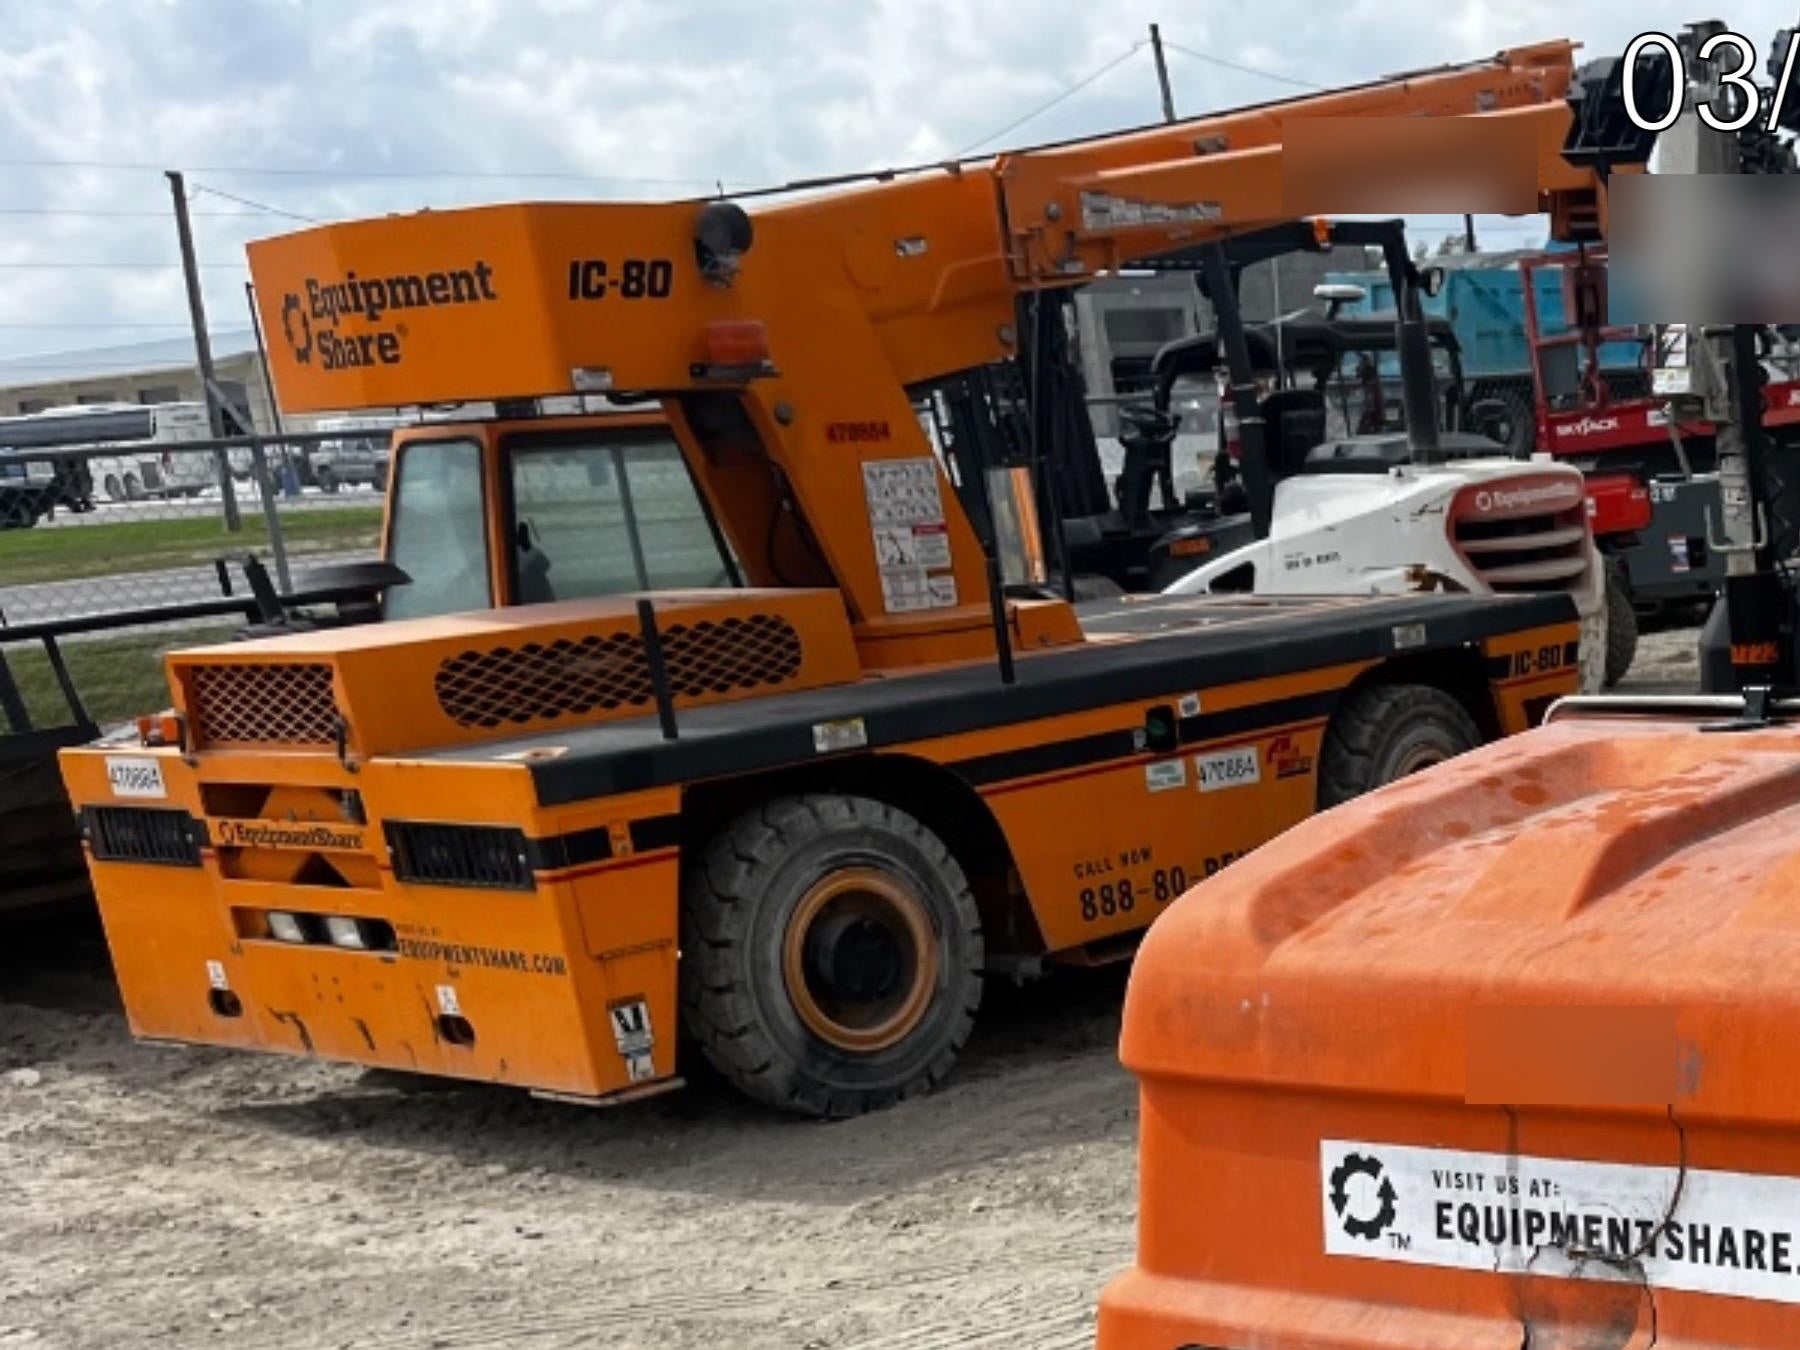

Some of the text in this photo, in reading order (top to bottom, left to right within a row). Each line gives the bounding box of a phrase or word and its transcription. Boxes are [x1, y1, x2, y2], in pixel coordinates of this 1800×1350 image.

[306, 259, 497, 327] Equipment
[568, 259, 673, 299] IC-80
[1556, 416, 1619, 437] SKYJACK
[1515, 644, 1561, 676] IC-80
[1073, 846, 1153, 881] CALL NOW
[1431, 1168, 1562, 1199] VISIT US AT:
